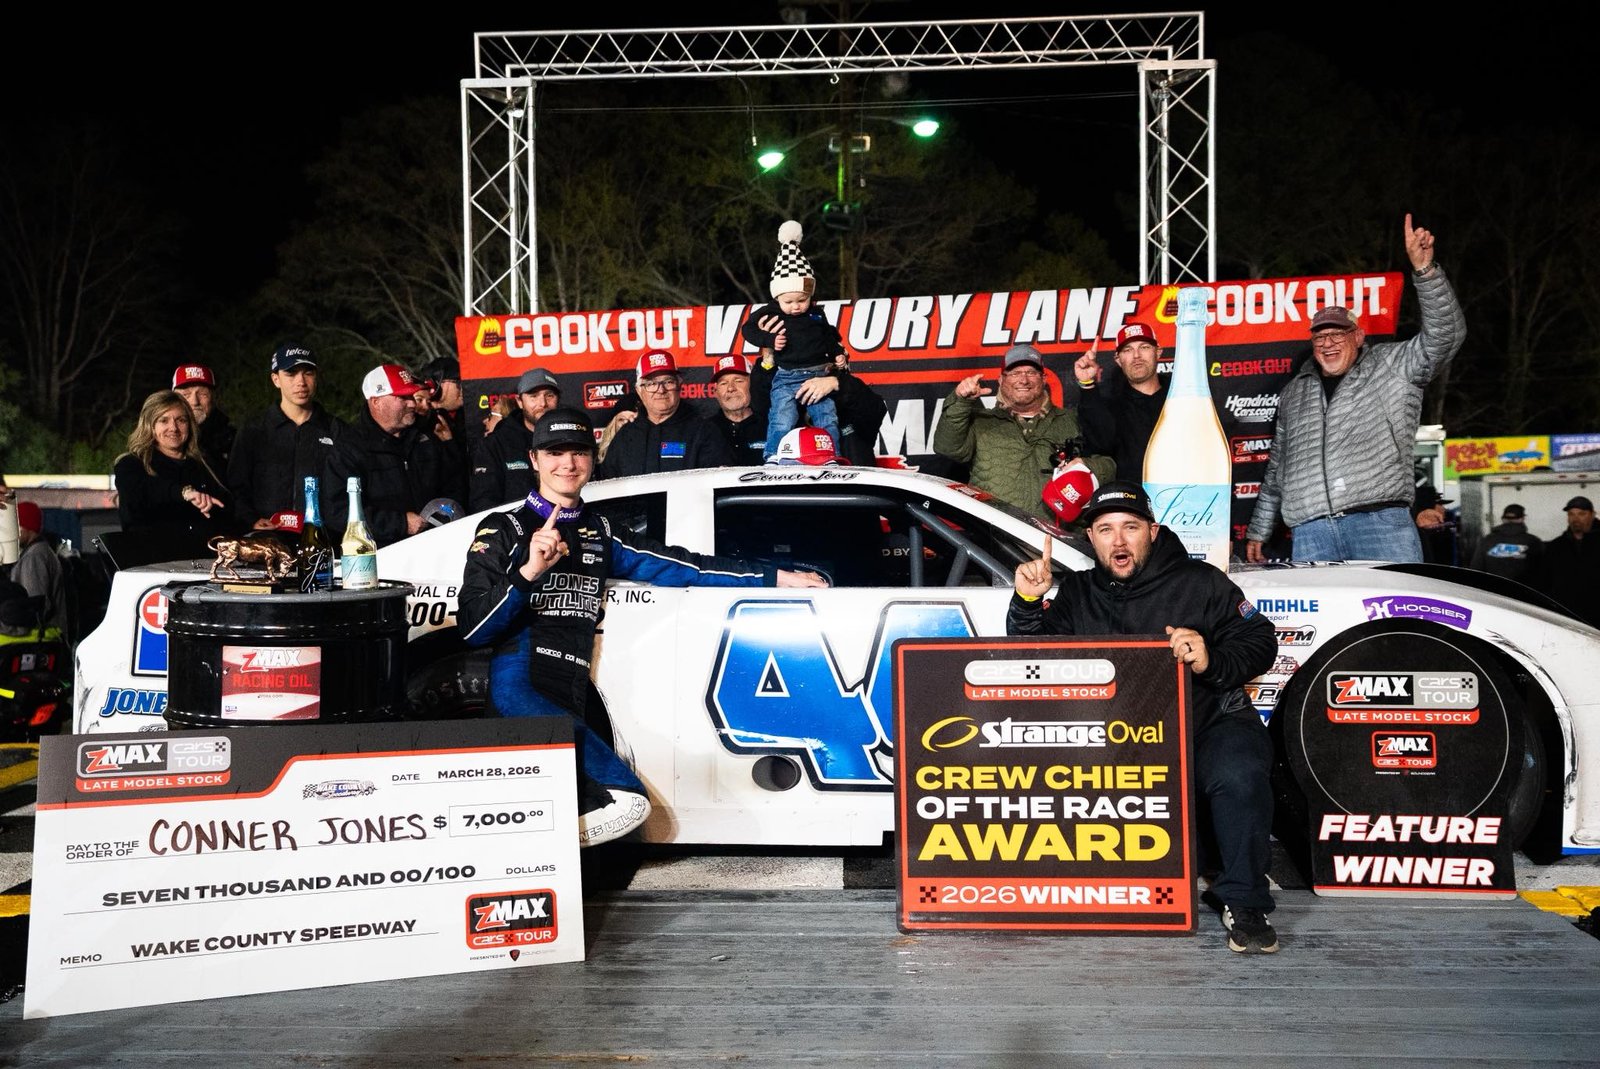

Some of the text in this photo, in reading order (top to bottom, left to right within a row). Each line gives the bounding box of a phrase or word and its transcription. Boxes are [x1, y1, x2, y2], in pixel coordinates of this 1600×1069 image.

[982, 285, 1142, 345] LANE
[505, 311, 617, 358] COOK
[1225, 393, 1280, 411] Hendrick
[625, 590, 656, 604] INC.
[1257, 599, 1319, 613] MAHLE
[1394, 603, 1467, 622] HOOSIER
[1041, 664, 1111, 679] TOUR
[232, 673, 313, 688] RACING OIL
[972, 687, 1108, 698] LATE MODEL STOCK
[1421, 691, 1471, 703] TOUR
[100, 687, 167, 717] JONE
[1334, 712, 1471, 722] LATE MODEL STOCK
[174, 755, 224, 768] TOUR
[391, 765, 540, 782] DATE MARCH 28, 2026
[915, 765, 1169, 790] CREW CHIEF
[83, 775, 223, 790] LATE MODEL STOCK
[916, 796, 1170, 820] OF THE RACE
[433, 815, 447, 831] $
[1318, 814, 1502, 844] FEATURE
[149, 813, 428, 856] CONNER JONES
[917, 823, 1171, 862] AWARD
[66, 840, 140, 853] PAY TO THE
[66, 849, 134, 860] ORDER OF
[1333, 855, 1495, 886] WINNER
[102, 887, 189, 907] SEVEN
[195, 875, 331, 900] THOUSAND
[335, 871, 386, 888] AND
[505, 864, 556, 875] DOLLARS
[941, 886, 1151, 905] 2026 WINNER
[60, 919, 416, 965] MEMO WAKE COUNTY SPEEDWAY
[515, 930, 552, 942] TOUR
